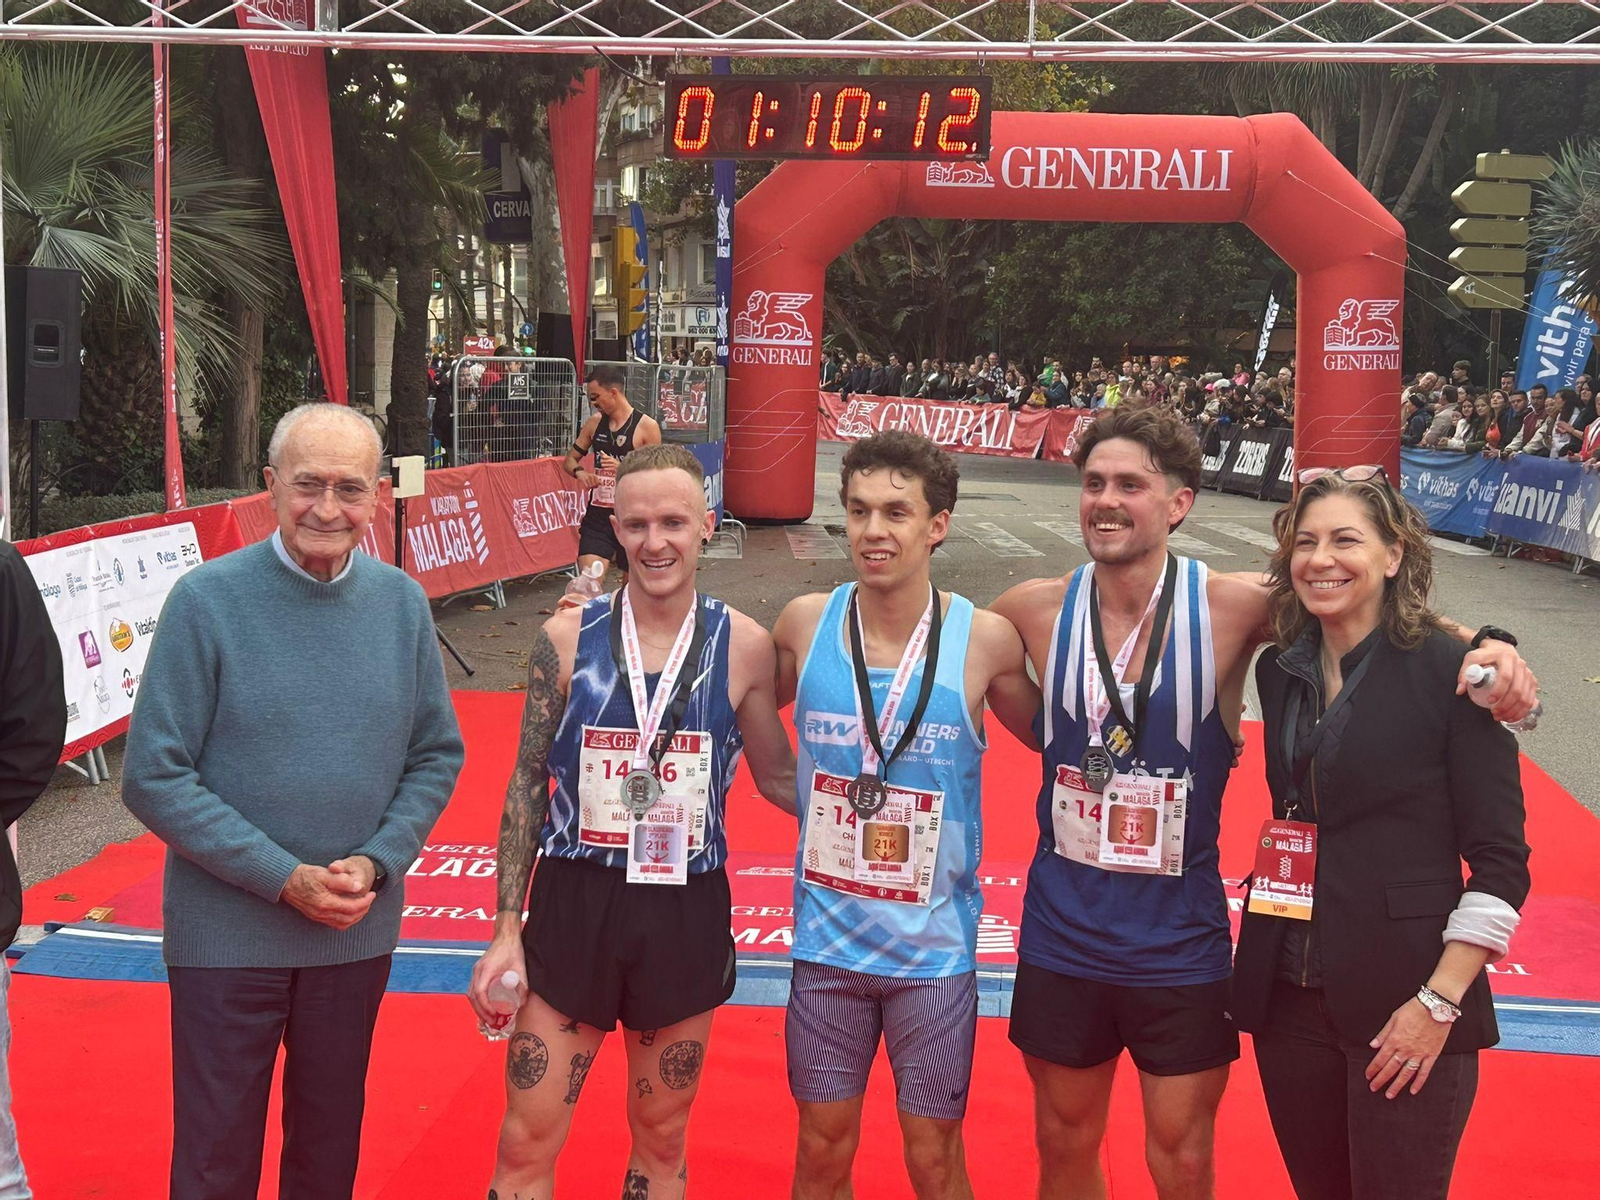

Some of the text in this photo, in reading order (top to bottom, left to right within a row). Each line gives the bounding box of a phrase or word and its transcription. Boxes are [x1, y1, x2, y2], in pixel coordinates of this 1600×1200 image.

[1001, 146, 1233, 192] GENERALI
[732, 347, 812, 365] GENERALI
[1323, 351, 1399, 370] GENERALI
[877, 400, 1020, 451] GENERALI
[1429, 475, 1460, 498] vithas
[407, 514, 475, 573] MÁLAGA
[1120, 821, 1144, 833] 21K
[646, 840, 669, 851] 21K
[874, 838, 897, 850] 21K
[1272, 904, 1288, 913] VIP
